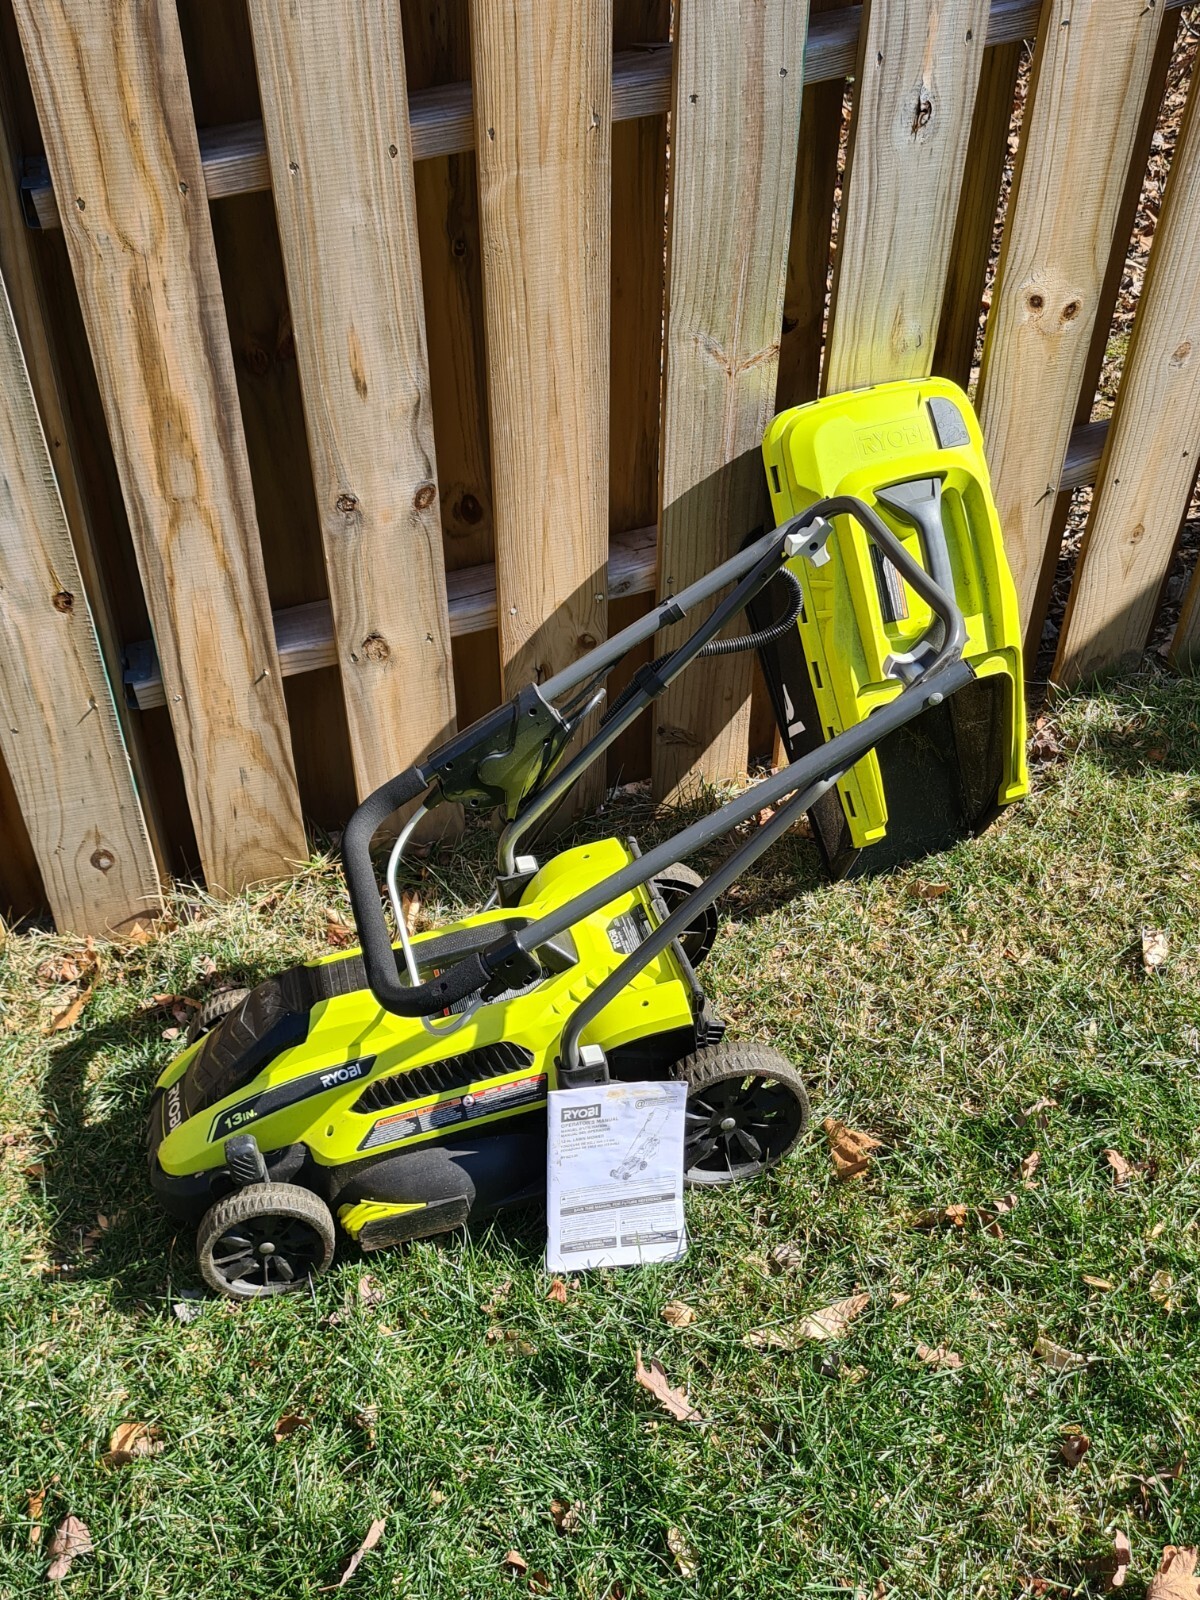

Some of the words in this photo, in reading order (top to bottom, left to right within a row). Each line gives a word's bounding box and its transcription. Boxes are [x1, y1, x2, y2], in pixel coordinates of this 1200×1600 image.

[858, 424, 926, 455] RYOBI
[319, 1063, 362, 1088] RYOBI
[563, 1106, 600, 1120] RYOBI
[596, 1116, 619, 1124] MANUAL
